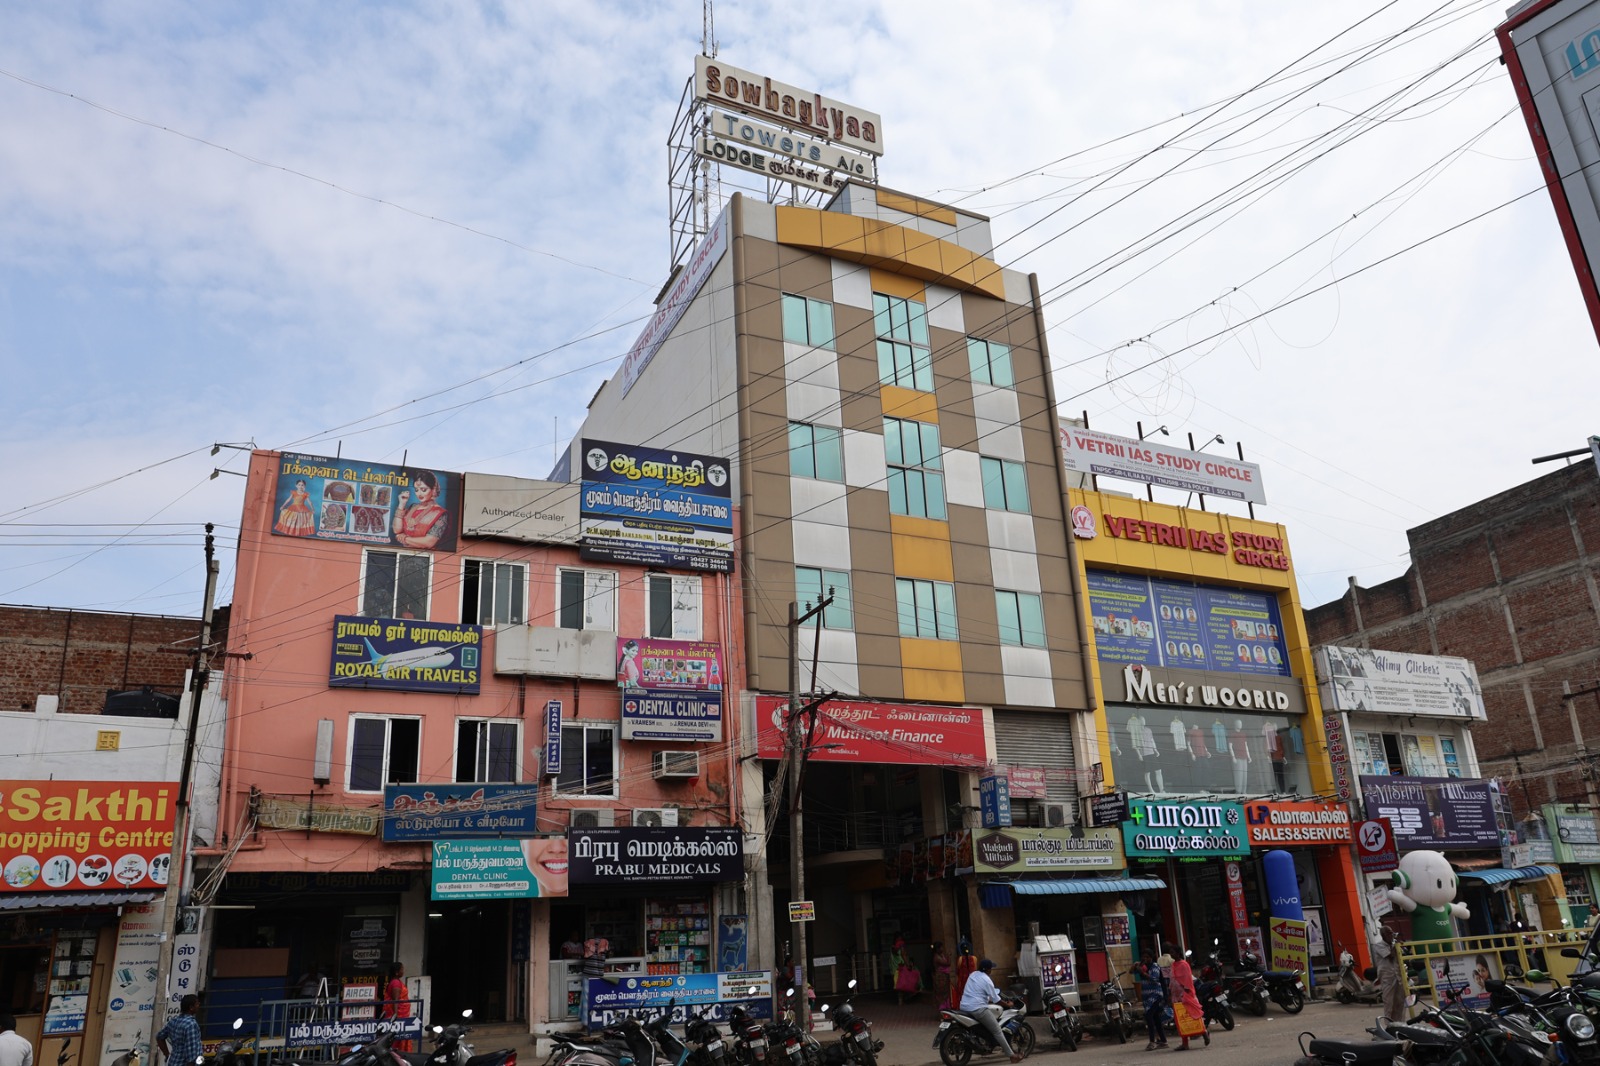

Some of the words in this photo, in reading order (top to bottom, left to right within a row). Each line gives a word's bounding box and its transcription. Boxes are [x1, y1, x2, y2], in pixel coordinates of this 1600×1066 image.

[706, 65, 876, 144] Sowbagkyaa
[723, 114, 821, 161] Towers
[703, 139, 765, 170] LODGE
[654, 309, 666, 334] IAS
[667, 271, 690, 312] STUDY
[691, 227, 720, 276] CIRCLE
[610, 453, 705, 487] ஆனந்தி
[1074, 436, 1125, 458] VETRII
[1128, 447, 1153, 463] IAS
[1156, 452, 1201, 472] STUDY
[1205, 463, 1253, 483] CIRCLE
[586, 486, 613, 508] மூலம்
[702, 504, 728, 519] சாலை
[481, 507, 532, 519] Authorized
[534, 512, 565, 522] Dealer
[1104, 514, 1188, 549] VETRII
[1188, 528, 1229, 555] IAS
[1232, 531, 1283, 553] STUDY
[1235, 549, 1290, 572] CIRCLE
[337, 619, 381, 639] ராயல்
[386, 622, 406, 642] ஏர்
[410, 626, 479, 644] டிராவல்ஸ்
[335, 662, 381, 678] ROYAL
[386, 666, 410, 680] AIR
[415, 667, 477, 684] TRAVELS
[639, 699, 675, 715] DENTAL
[676, 702, 706, 717] CLINIC
[1201, 685, 1289, 710] WOORLD
[827, 725, 890, 742] Muthoot
[892, 729, 944, 744] Finance
[8, 787, 169, 821] Sakthi
[1270, 804, 1349, 825] மொபைல்ஸ்
[463, 817, 473, 828] &
[476, 814, 526, 829] வீடியோ
[1146, 804, 1223, 828] பாவா
[98, 826, 174, 849] Centre
[1022, 832, 1062, 855] மால்குடி
[1135, 828, 1241, 852] மெடிக்கல்ஸ்
[1253, 827, 1351, 842] SALES&SERVICE
[575, 836, 620, 862] பிரபு
[627, 836, 738, 862] மெடிக்கல்ஸ்
[985, 852, 1014, 863] Mithais
[435, 854, 451, 869] பல்
[453, 853, 524, 871] மருத்துவமனை
[595, 864, 644, 876] PRABU
[648, 863, 721, 875] MEDICALS
[452, 873, 481, 881] DENTAL
[1273, 896, 1298, 906] vivo
[345, 986, 373, 997] AIRCEL
[641, 978, 673, 988] ஆனந்தி
[111, 1000, 124, 1009] Jio
[290, 1022, 310, 1039] பல்
